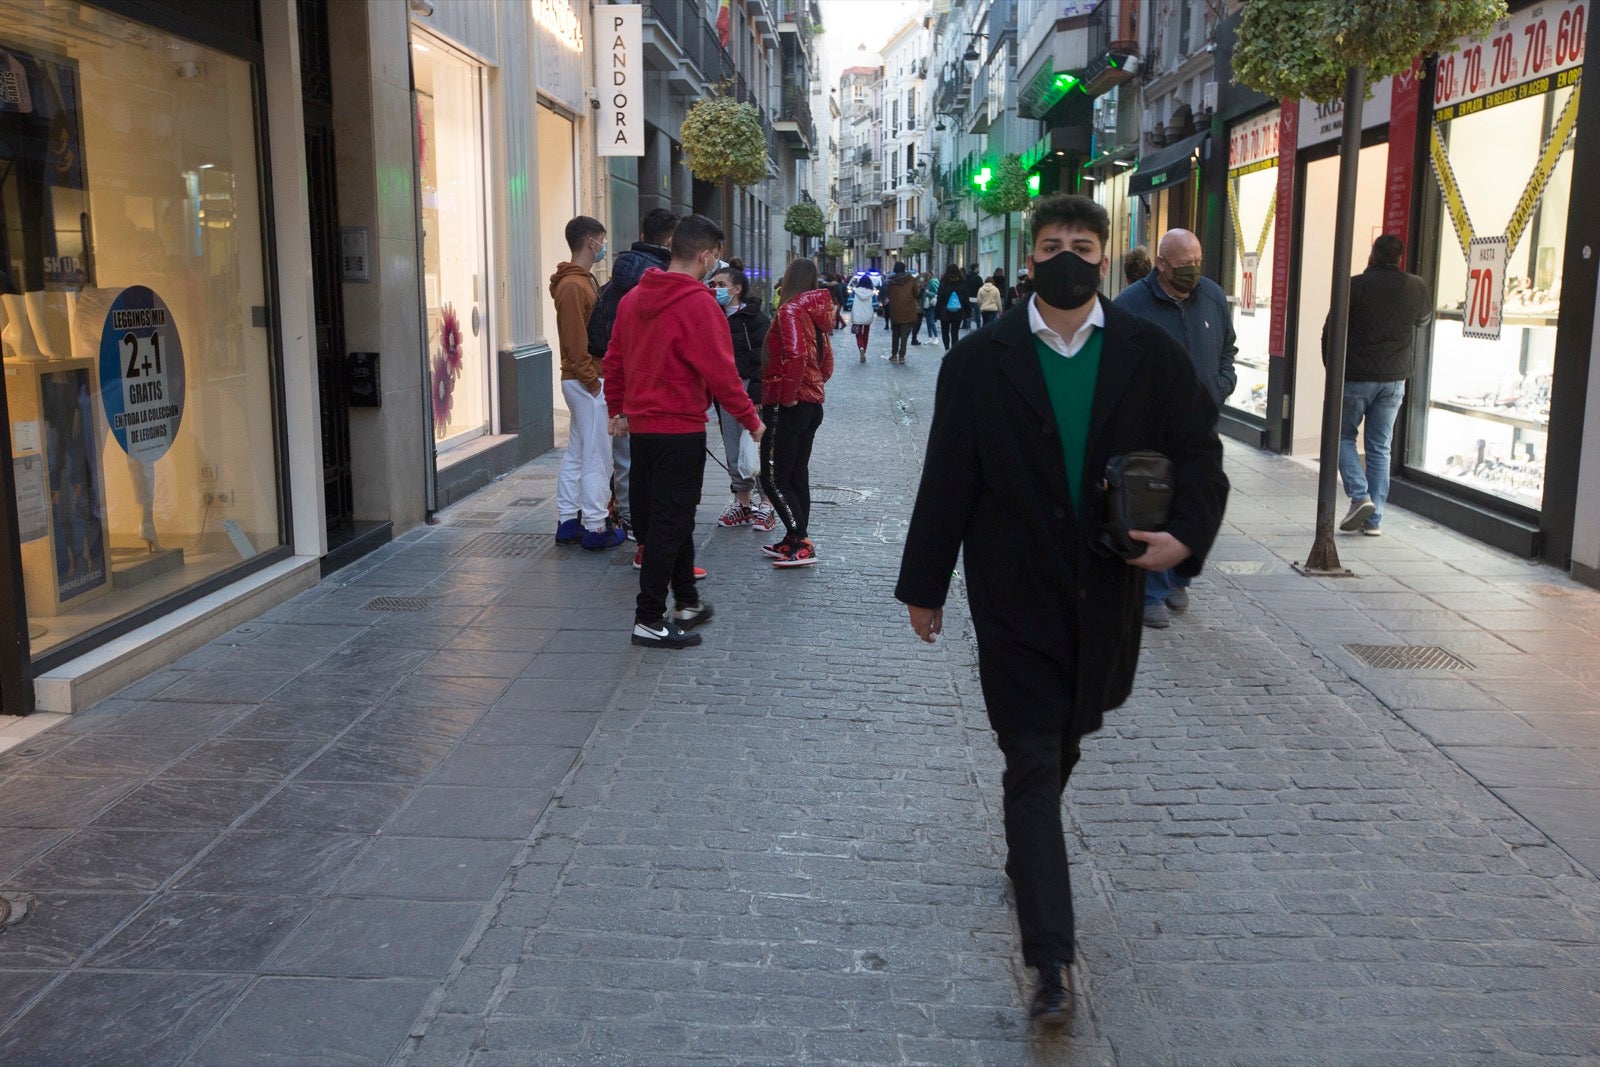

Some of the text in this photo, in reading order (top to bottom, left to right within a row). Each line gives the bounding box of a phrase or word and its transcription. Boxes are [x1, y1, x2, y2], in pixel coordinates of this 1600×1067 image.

[1435, 56, 1454, 105] 60
[1461, 45, 1482, 96] 70
[1491, 32, 1513, 87] 70
[1522, 19, 1547, 77] 70
[1555, 4, 1584, 66] 60
[6, 72, 19, 103] GRATIS
[612, 17, 627, 144] PANDORA
[1459, 103, 1467, 116] EN
[1467, 98, 1483, 114] PLATA
[1486, 95, 1494, 108] EN
[1519, 85, 1528, 99] EN
[1529, 78, 1549, 96] ACERO
[1557, 72, 1567, 87] EN
[1262, 123, 1271, 157] 70
[1510, 167, 1545, 242] ALMACENES
[1479, 249, 1495, 262] HASTA
[1243, 272, 1253, 309] 70
[1468, 268, 1493, 328] 70
[113, 309, 166, 329] LEGGINGS MIX
[124, 331, 162, 379] 2+1
[129, 380, 163, 405] GRATIS
[115, 404, 179, 429] EN TODA LA COLECCIÓN
[131, 424, 167, 444] DE LEGGINGS
